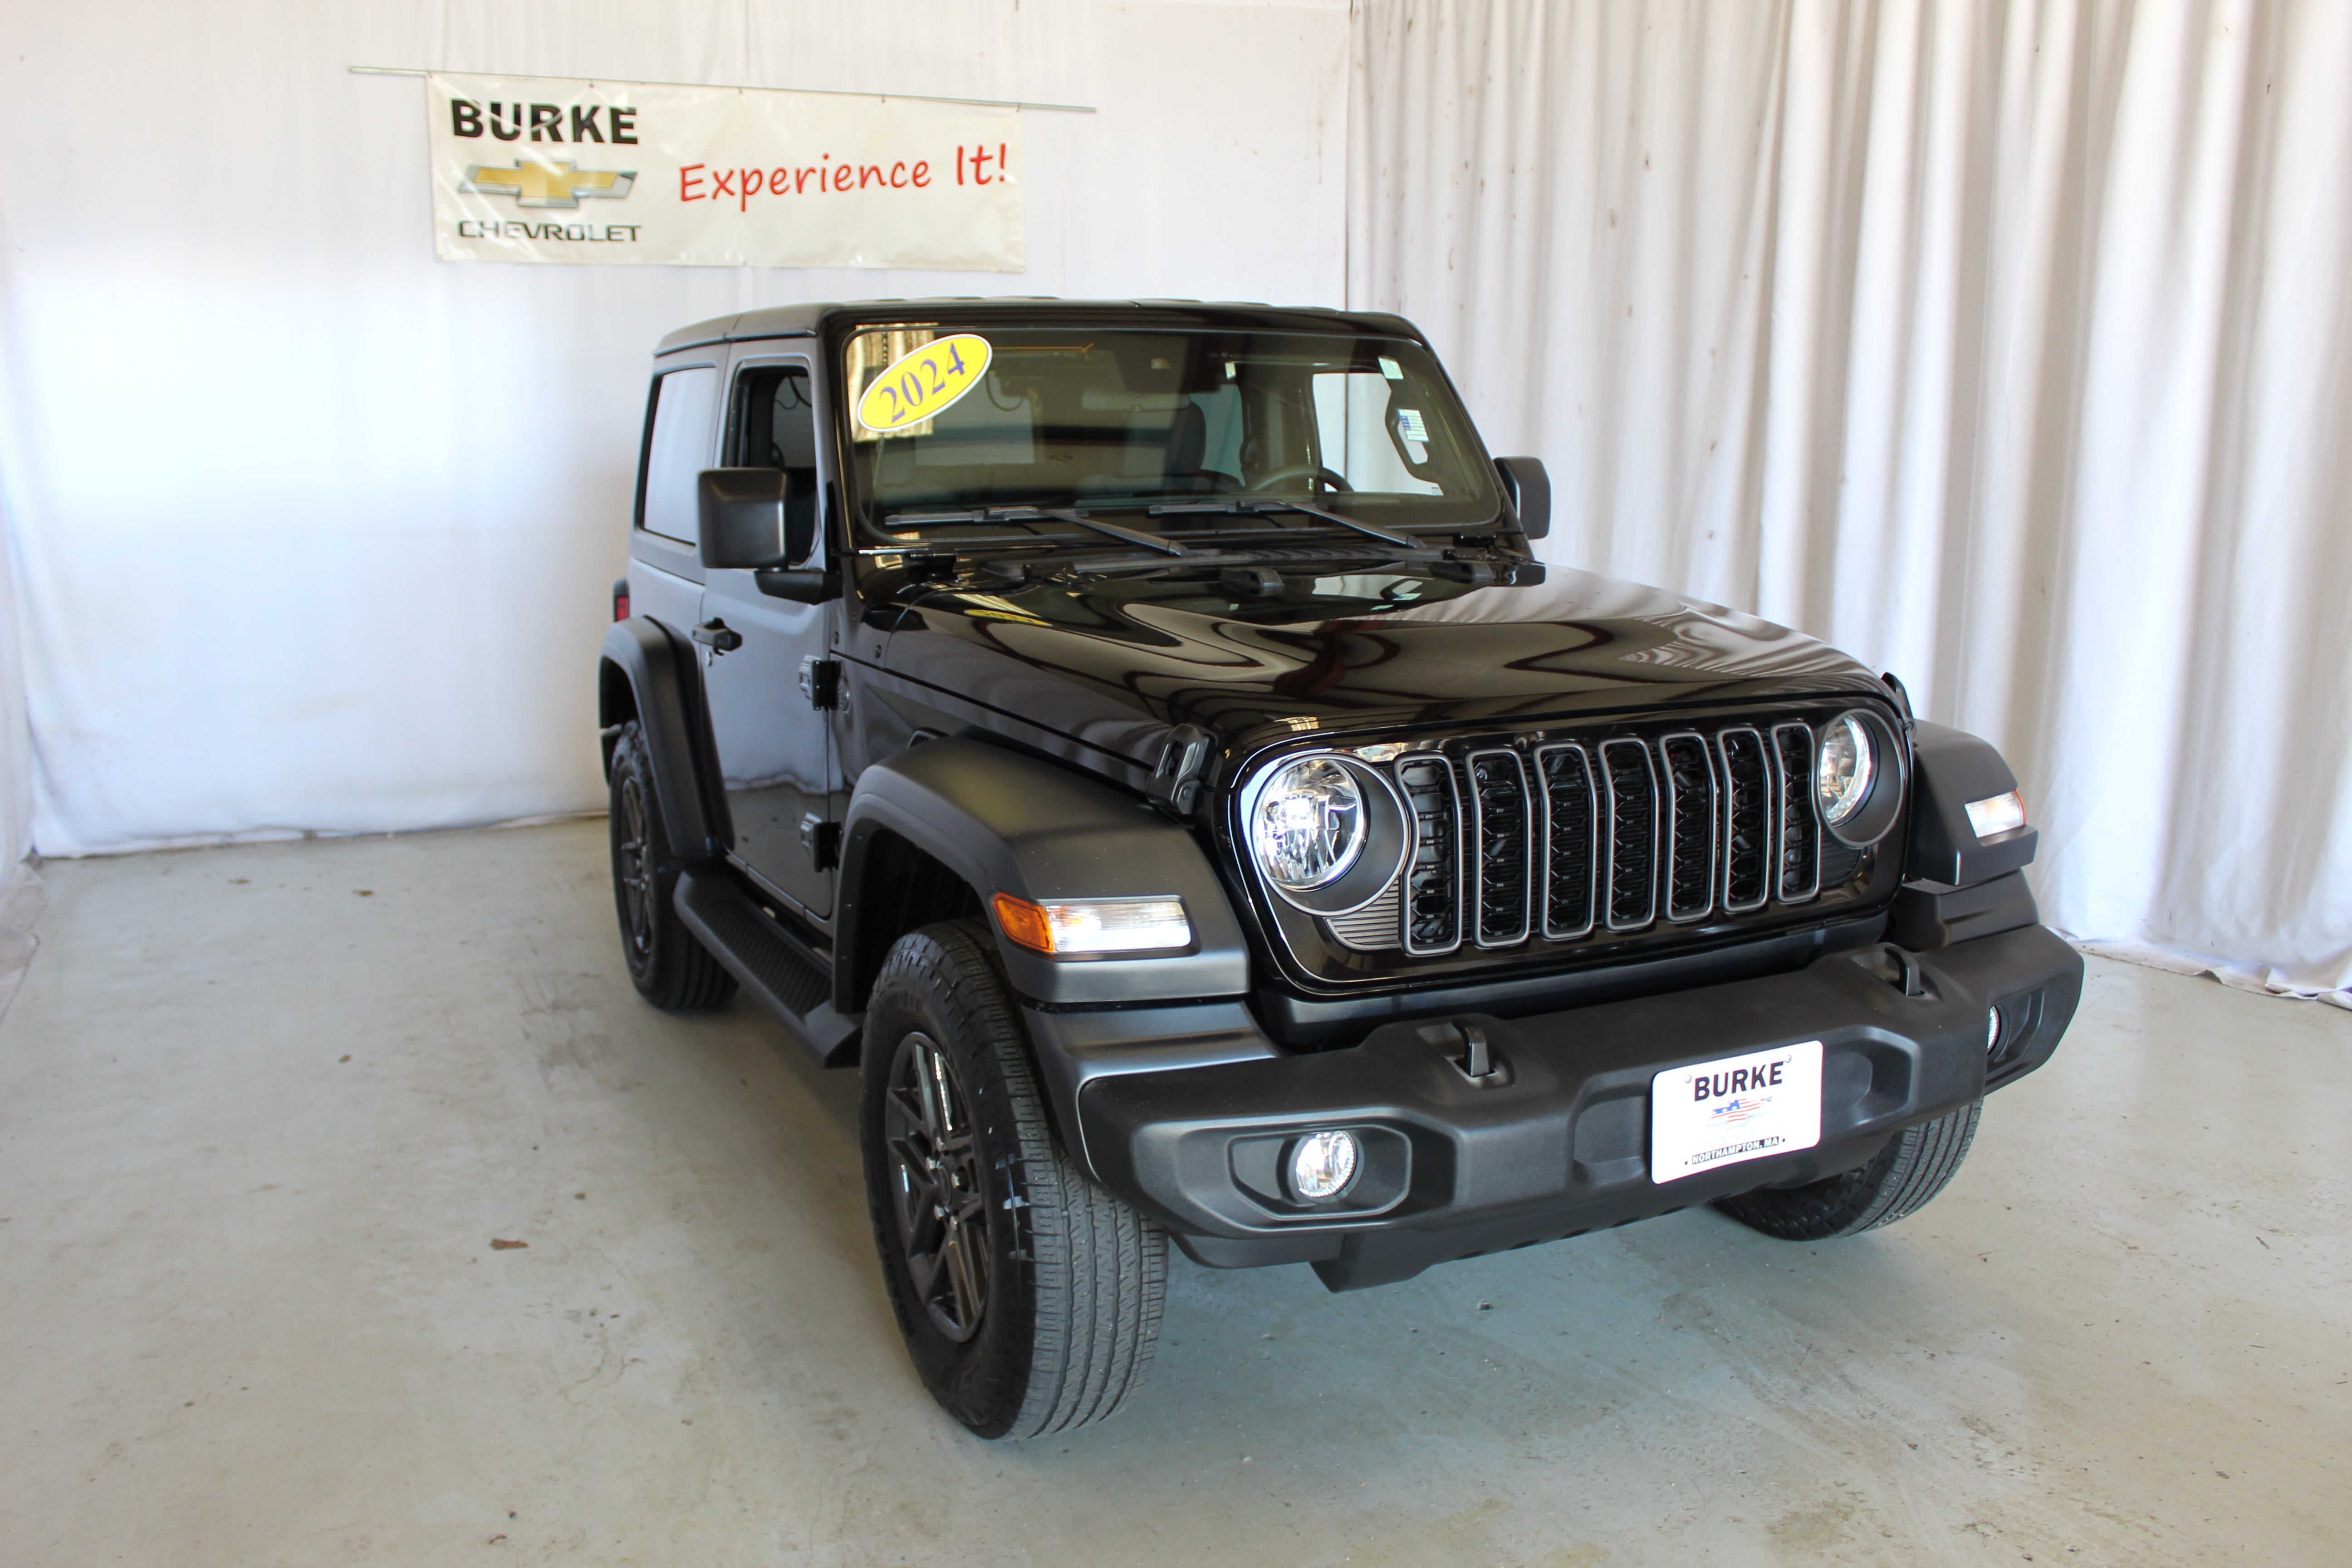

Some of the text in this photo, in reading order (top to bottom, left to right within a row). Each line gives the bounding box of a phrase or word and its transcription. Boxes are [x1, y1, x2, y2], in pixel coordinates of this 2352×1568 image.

[451, 98, 639, 145] BURKE
[680, 143, 1008, 212] Experience It!
[458, 220, 642, 242] CHEVROLET
[880, 342, 965, 423] 2024
[1694, 1061, 1784, 1102] BURKE
[1764, 1137, 1778, 1147] MA
